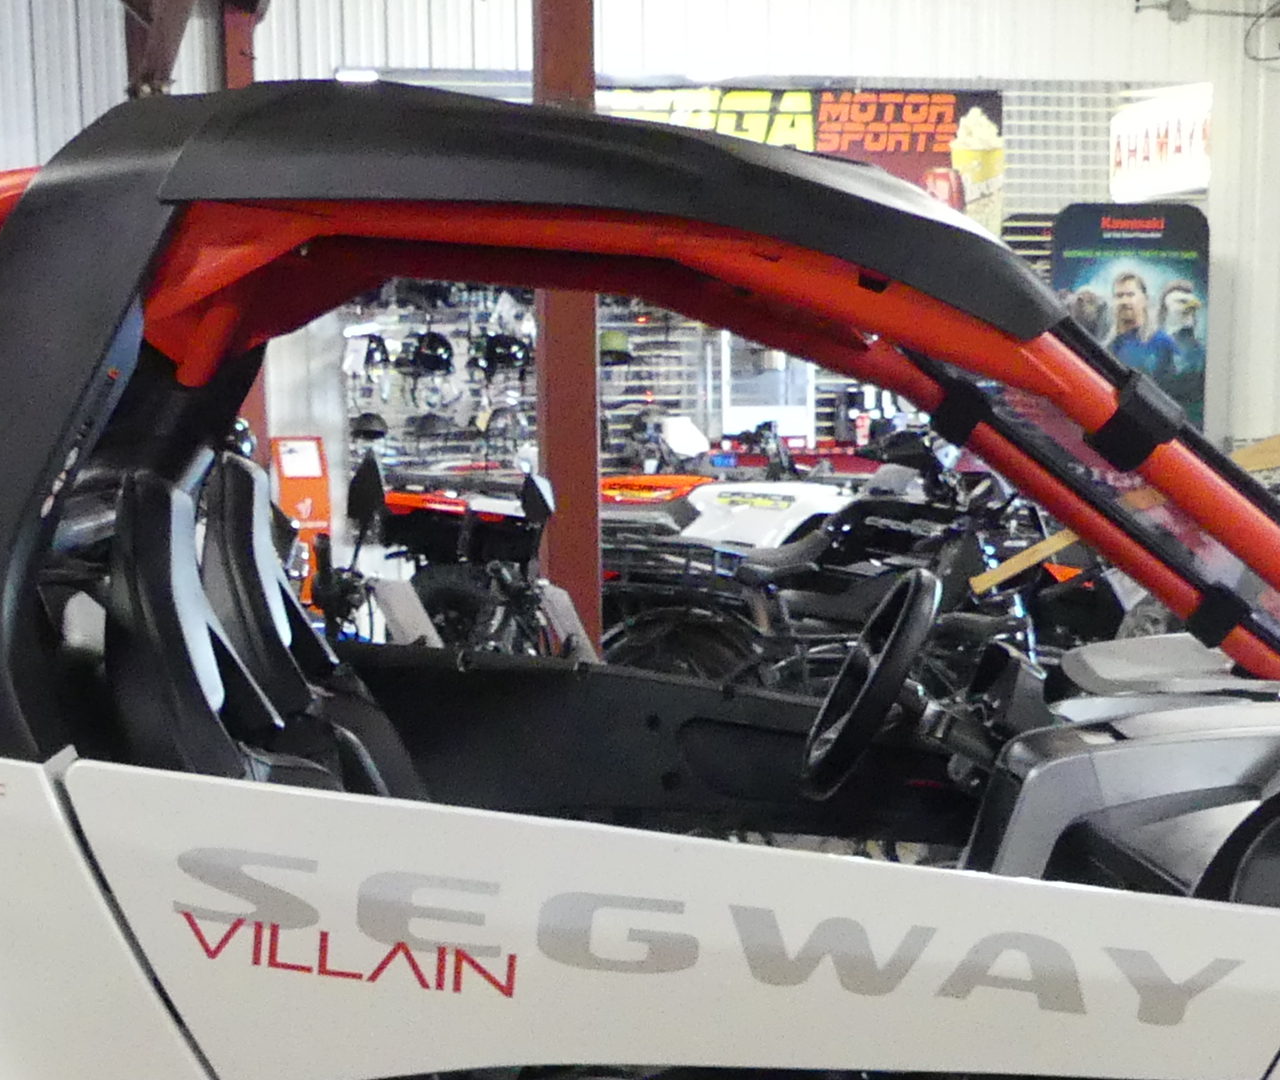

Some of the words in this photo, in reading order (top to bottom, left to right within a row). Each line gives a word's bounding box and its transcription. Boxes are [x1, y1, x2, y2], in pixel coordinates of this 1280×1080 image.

[818, 91, 957, 123] MOTOR
[816, 122, 958, 153] SPORTS
[173, 846, 1244, 1027] SEGWAY
[181, 910, 517, 998] VILLAIN
